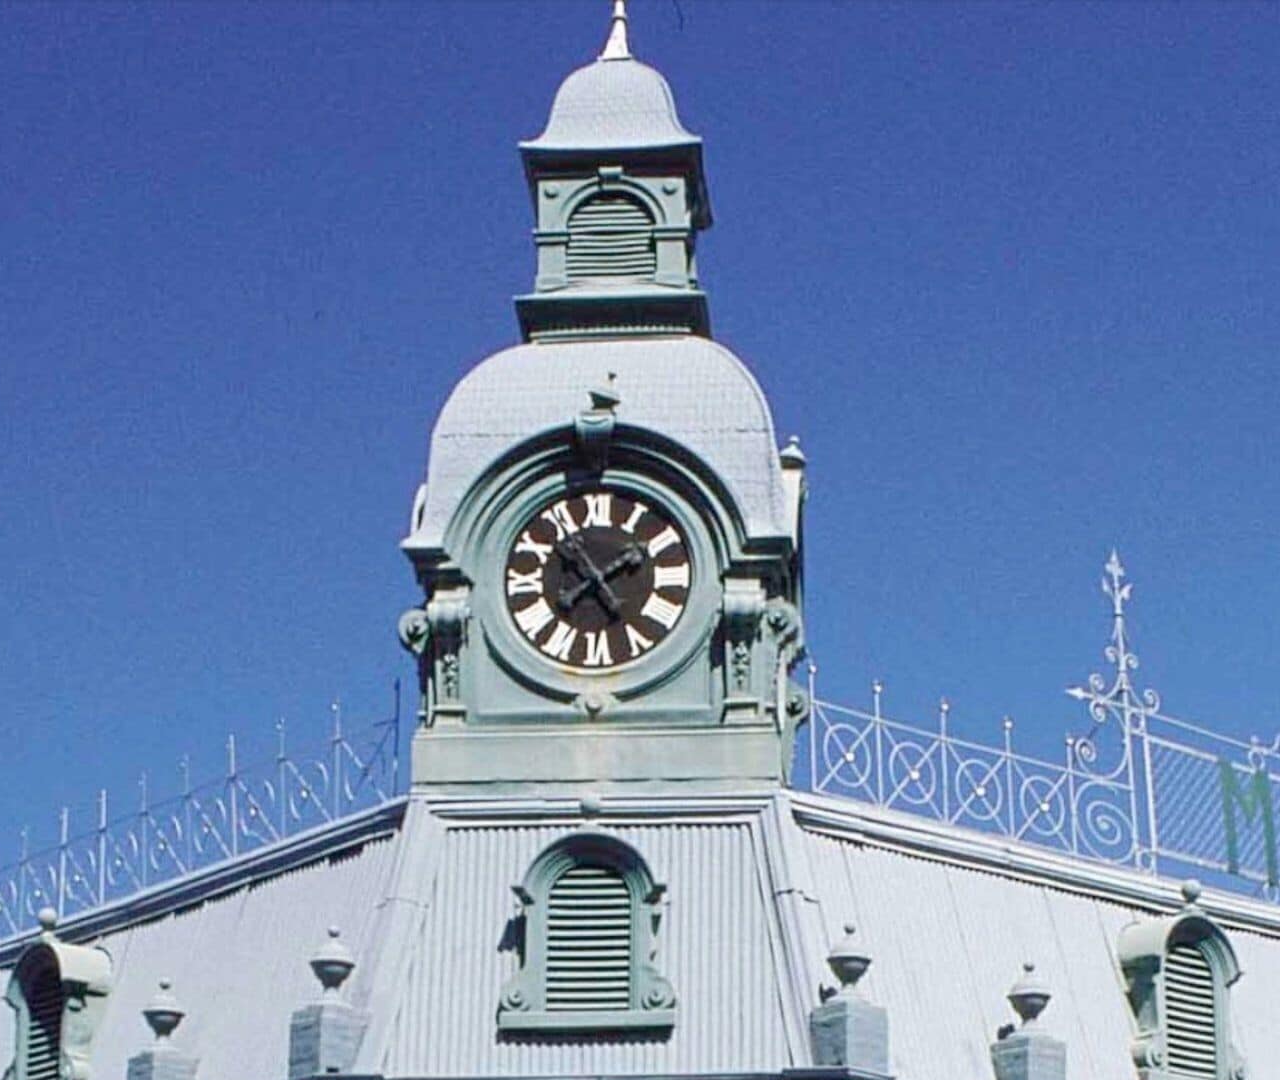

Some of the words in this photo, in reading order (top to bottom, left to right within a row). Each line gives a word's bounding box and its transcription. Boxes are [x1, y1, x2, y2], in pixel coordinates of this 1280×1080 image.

[583, 494, 614, 527] XII
[621, 502, 649, 533] I
[515, 531, 553, 564] X
[648, 526, 681, 557] II
[508, 568, 543, 596] IX
[654, 562, 689, 589] III
[583, 630, 613, 665] VI
[625, 624, 654, 656] V
